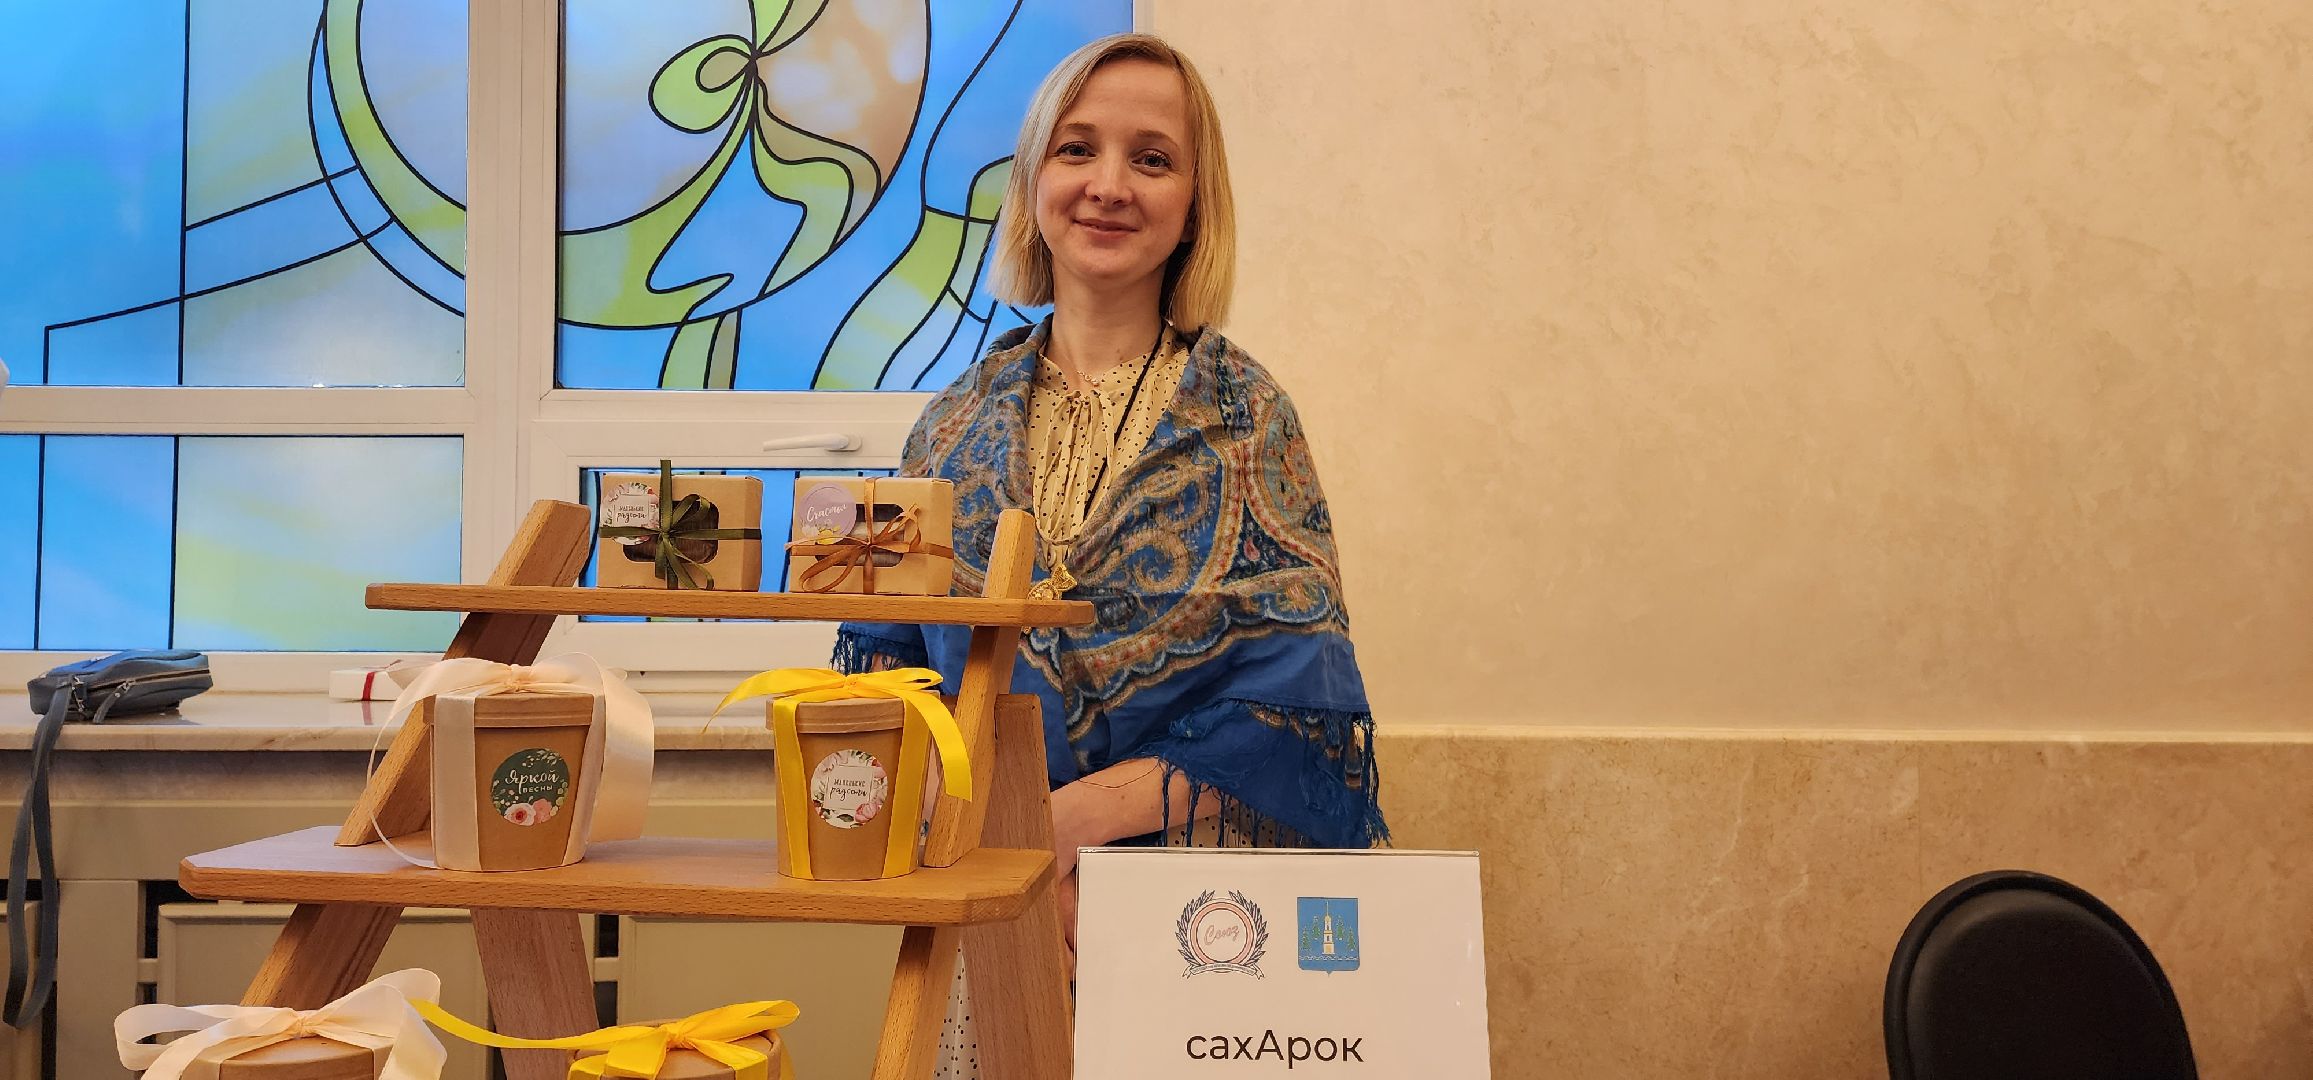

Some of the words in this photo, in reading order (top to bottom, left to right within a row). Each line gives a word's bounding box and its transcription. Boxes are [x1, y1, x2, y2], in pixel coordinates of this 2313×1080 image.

[504, 769, 560, 795] Яркой
[522, 785, 553, 793] ВЕСНЫ
[1203, 924, 1240, 946] Союз
[1186, 1029, 1365, 1070] сахАрок
